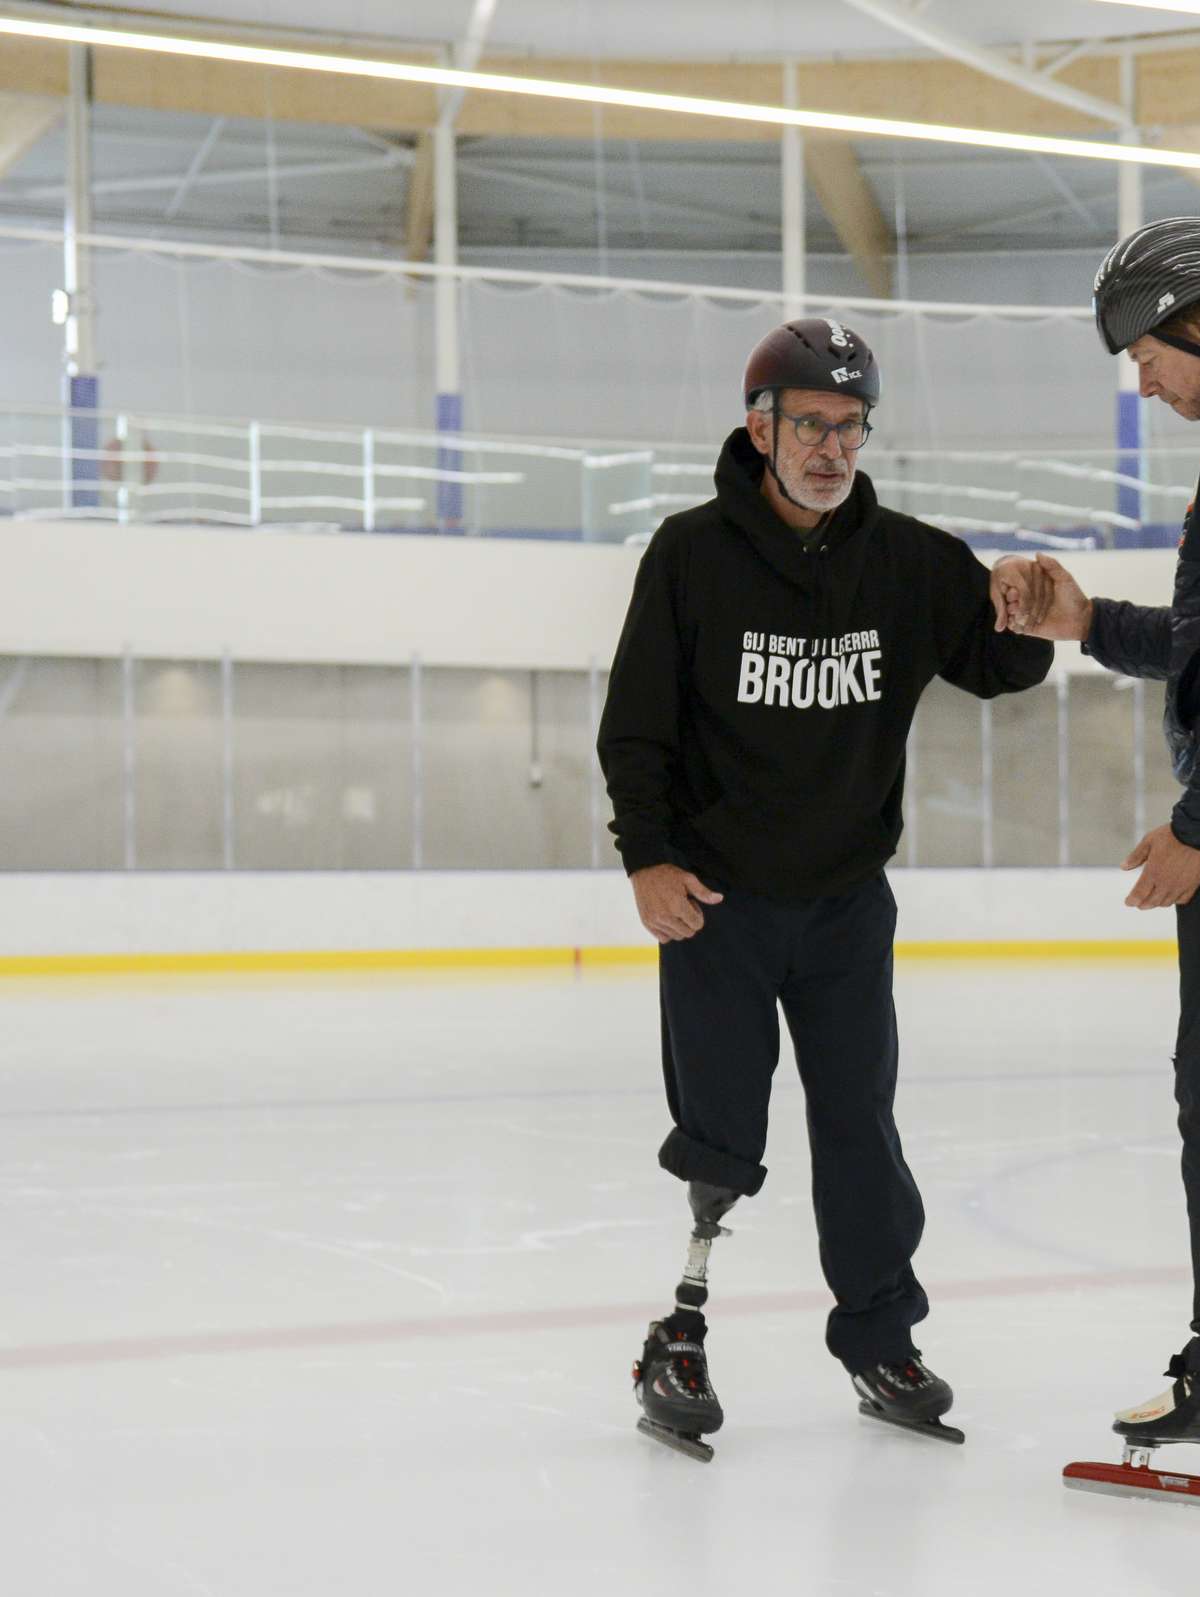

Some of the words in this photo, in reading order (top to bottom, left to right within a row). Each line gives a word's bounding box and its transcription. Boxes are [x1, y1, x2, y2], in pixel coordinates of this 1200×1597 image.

[743, 631, 765, 651] GIJ
[768, 634, 807, 657] BENT
[737, 650, 882, 709] BROOKE
